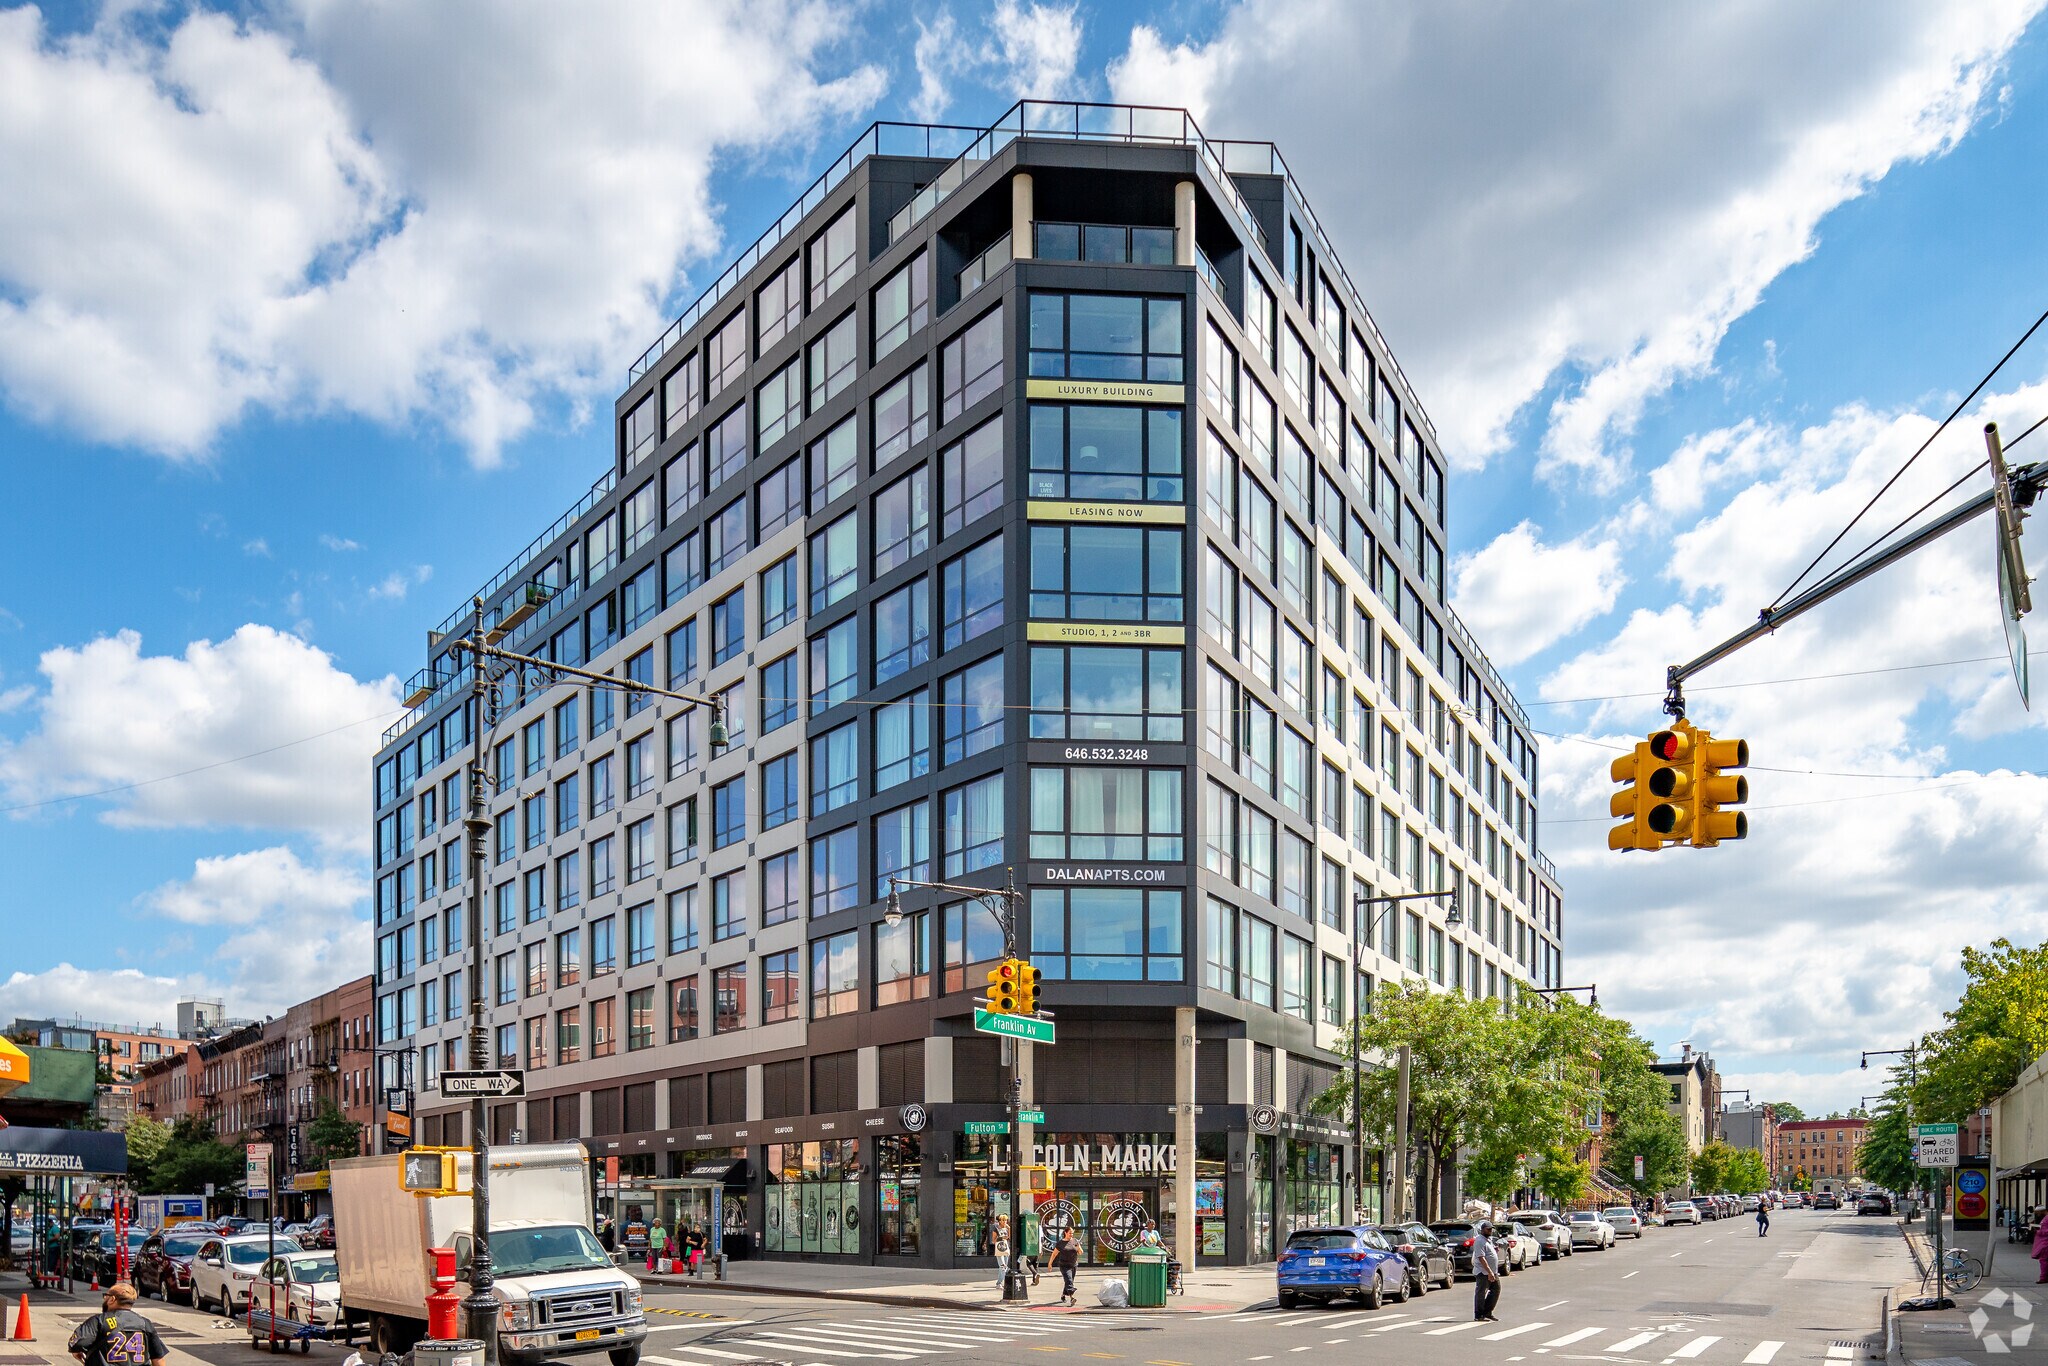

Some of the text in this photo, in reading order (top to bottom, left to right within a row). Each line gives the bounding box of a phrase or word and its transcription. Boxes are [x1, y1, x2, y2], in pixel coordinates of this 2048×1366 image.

[1058, 386, 1153, 397] LUXURY BUILDING
[1070, 508, 1144, 517] LEASING NOW
[1061, 628, 1098, 637] STUDIO,
[1101, 629, 1109, 638] 1,
[1065, 748, 1148, 760] 646.532.3248
[1046, 868, 1165, 881] DALANAPTS.COM
[993, 1017, 1036, 1035] Franklin Av
[453, 1079, 512, 1090] ONE WAY
[1019, 1113, 1038, 1122] Franklin
[970, 1124, 996, 1132] Fulton
[17, 1153, 83, 1170] PIZZERIA
[992, 1144, 1176, 1172] LICOLN MARKE
[107, 1331, 145, 1362] 24
